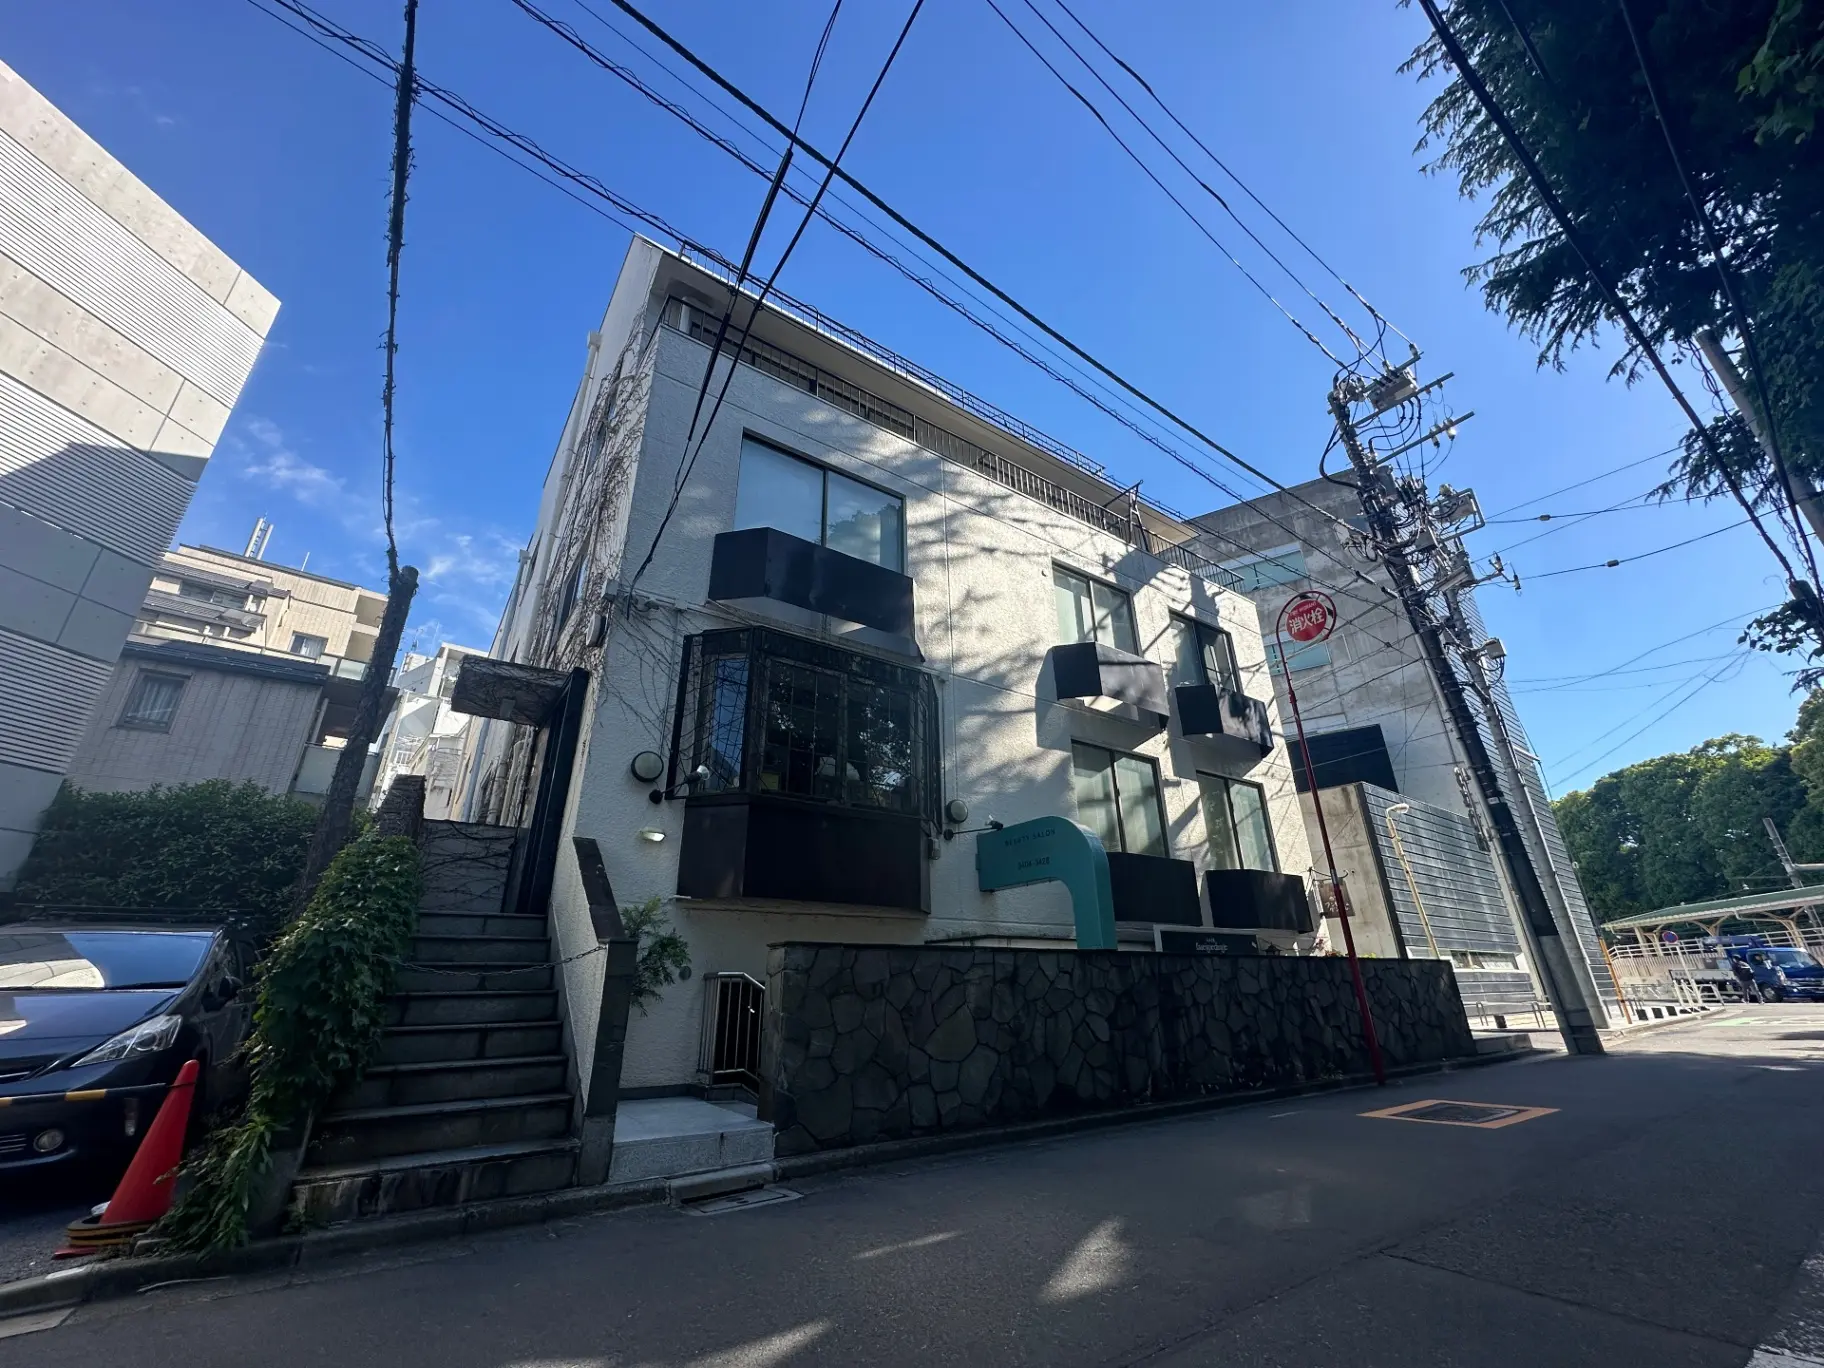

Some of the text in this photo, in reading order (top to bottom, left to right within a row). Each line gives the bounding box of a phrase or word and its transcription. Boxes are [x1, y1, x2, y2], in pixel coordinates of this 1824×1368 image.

[1289, 607, 1325, 635] 消火栓
[1004, 828, 1056, 847] BEAUTY SALON
